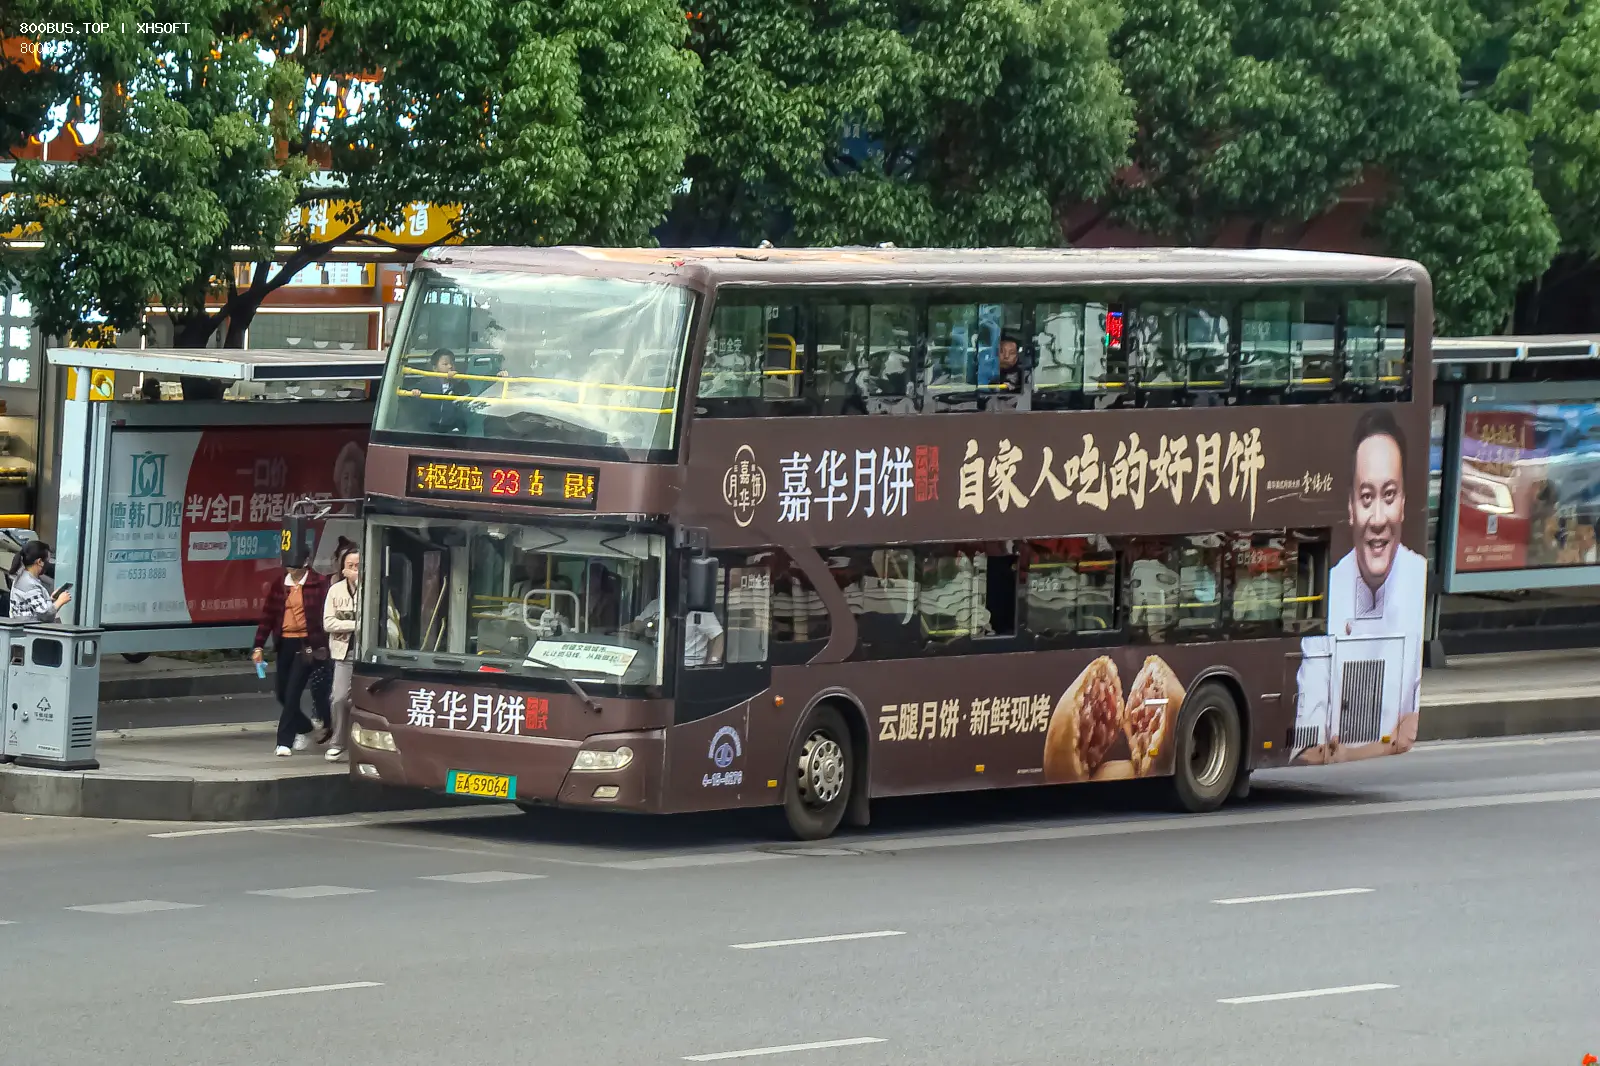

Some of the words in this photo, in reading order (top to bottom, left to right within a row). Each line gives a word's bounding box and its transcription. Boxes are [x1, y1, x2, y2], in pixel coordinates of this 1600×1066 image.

[236, 456, 288, 488] 一口价
[491, 468, 521, 495] 23
[777, 445, 914, 522] 嘉华月饼
[958, 427, 1265, 522] 自家人吃的好月饼
[110, 501, 182, 528] 德韩口腔
[185, 493, 244, 524] 半/全口
[281, 529, 291, 551] 23
[406, 688, 526, 735] 嘉华月饼
